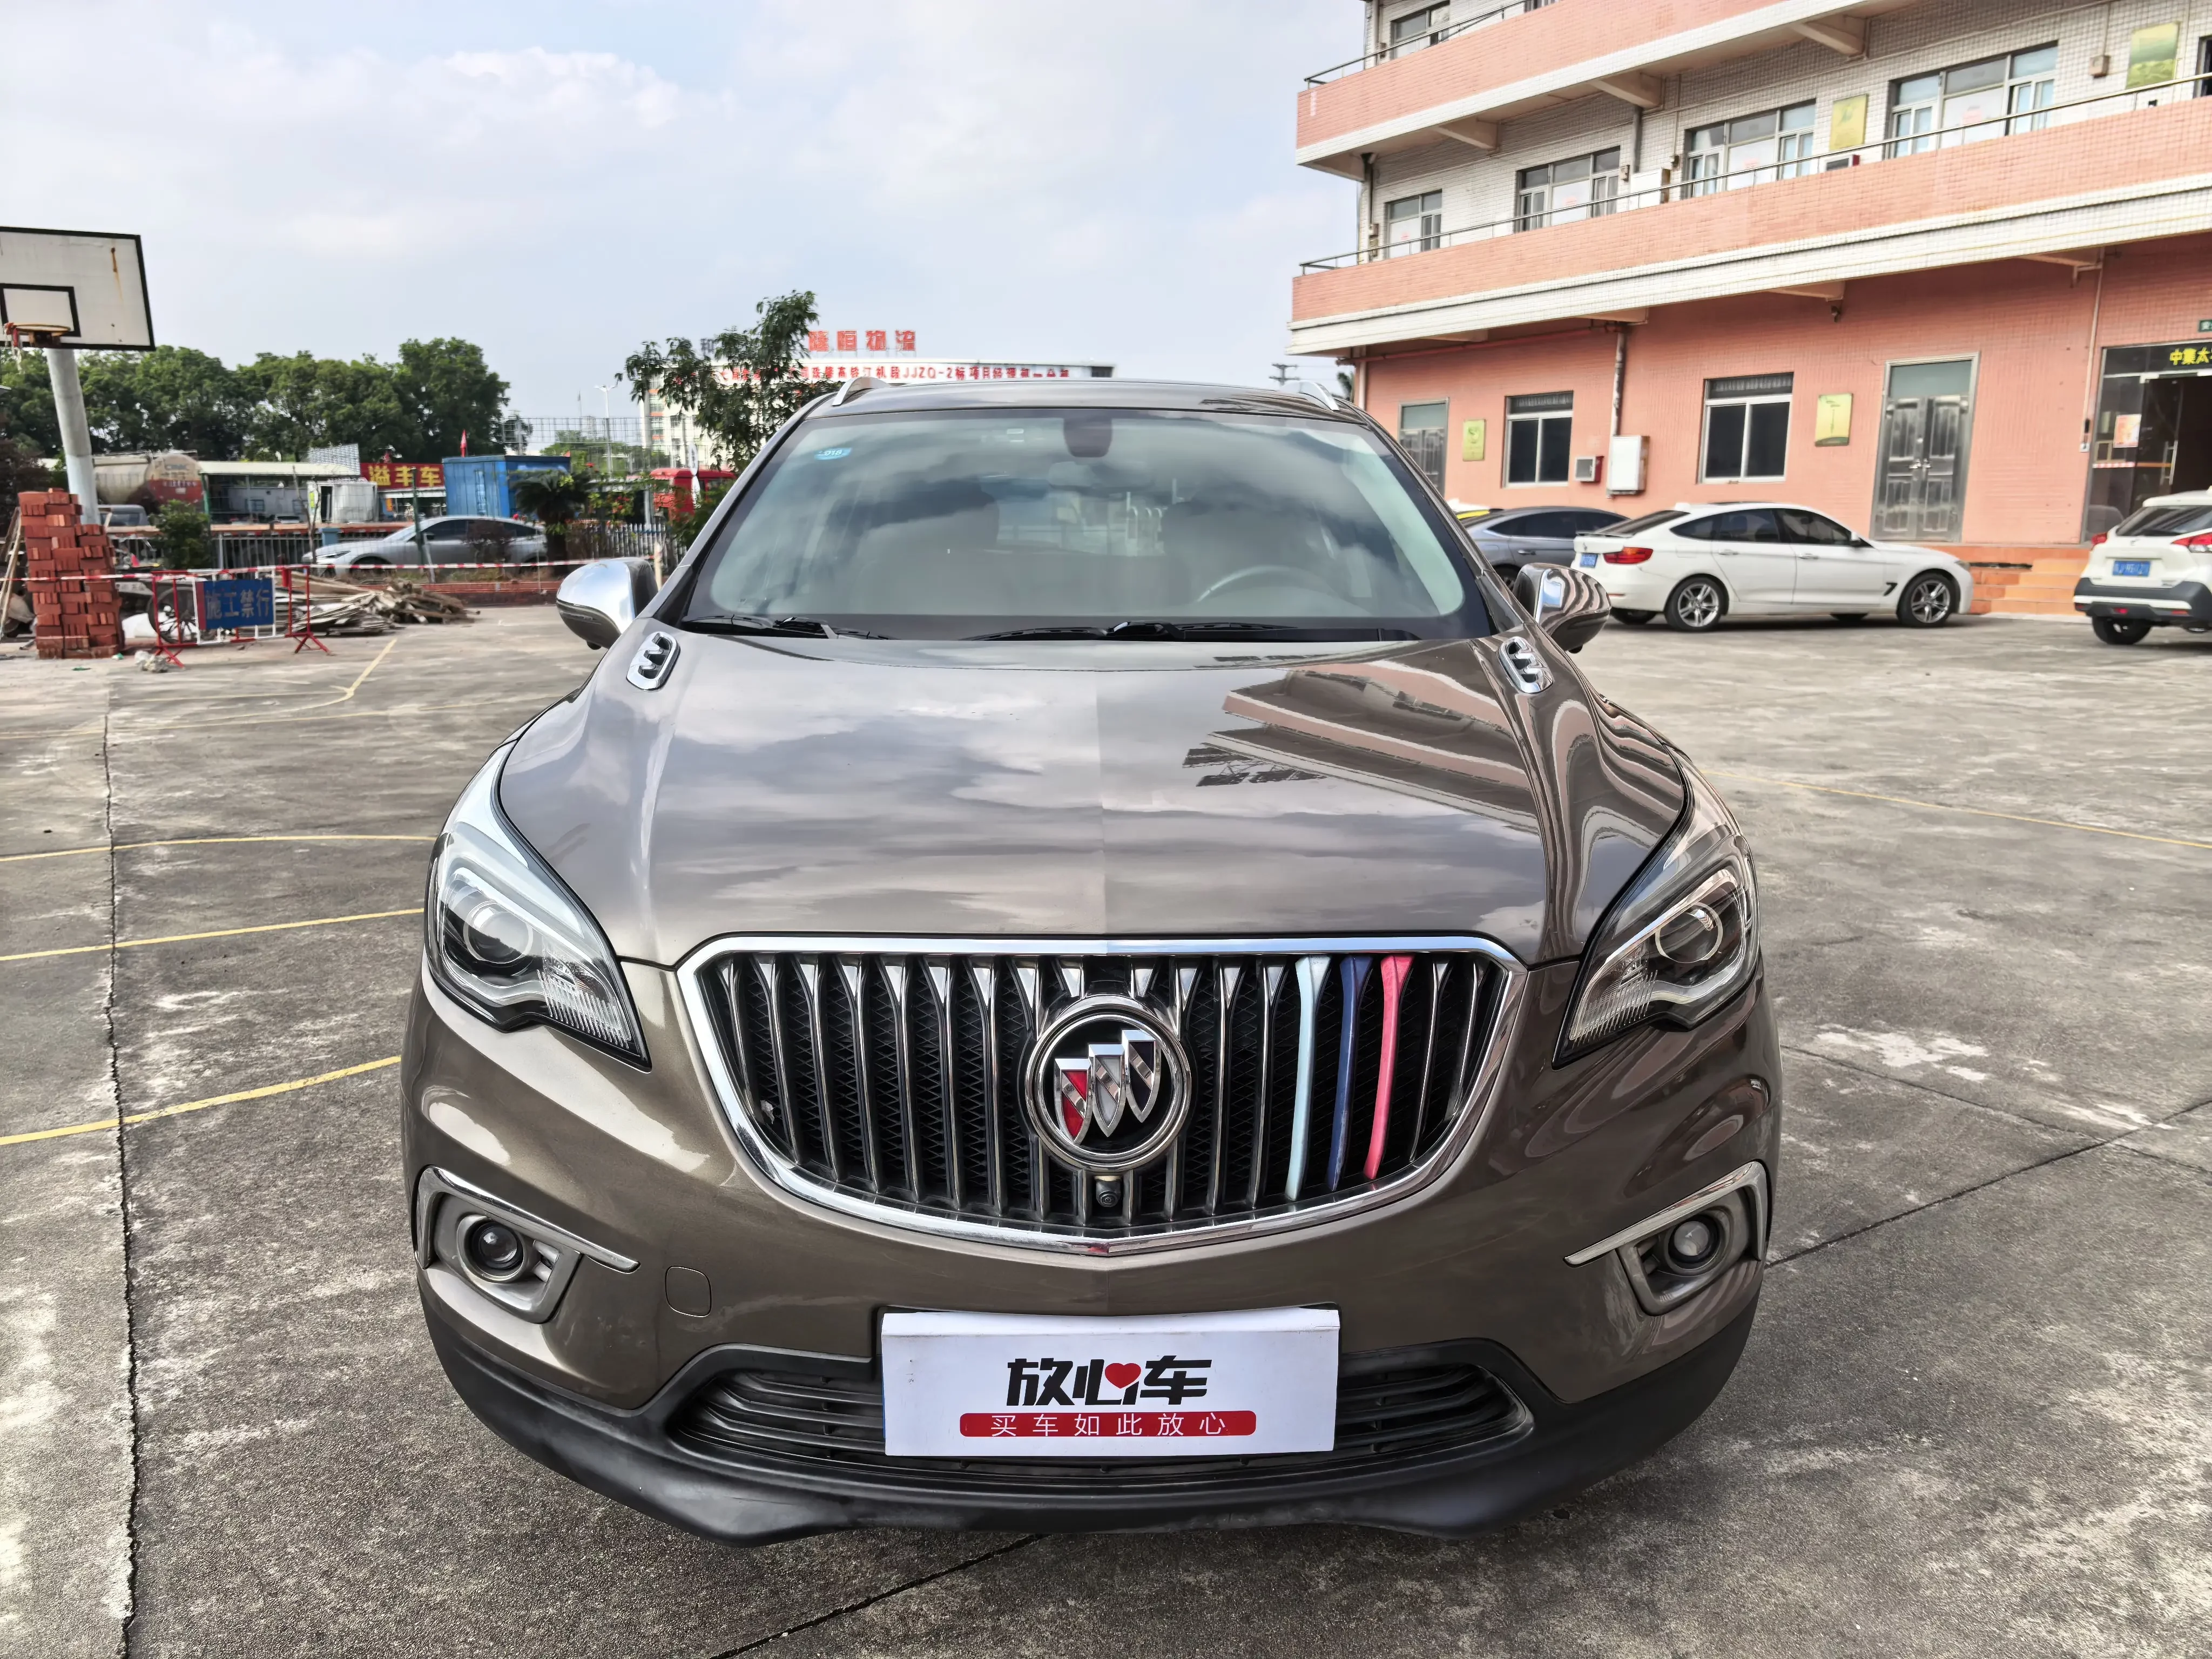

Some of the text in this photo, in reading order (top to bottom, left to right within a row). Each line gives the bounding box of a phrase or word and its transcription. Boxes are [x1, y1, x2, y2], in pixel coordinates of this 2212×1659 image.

[205, 589, 270, 619] 施工禁行
[1006, 1355, 1212, 1406] 放心车
[990, 1412, 1226, 1437] 买车如此放心
